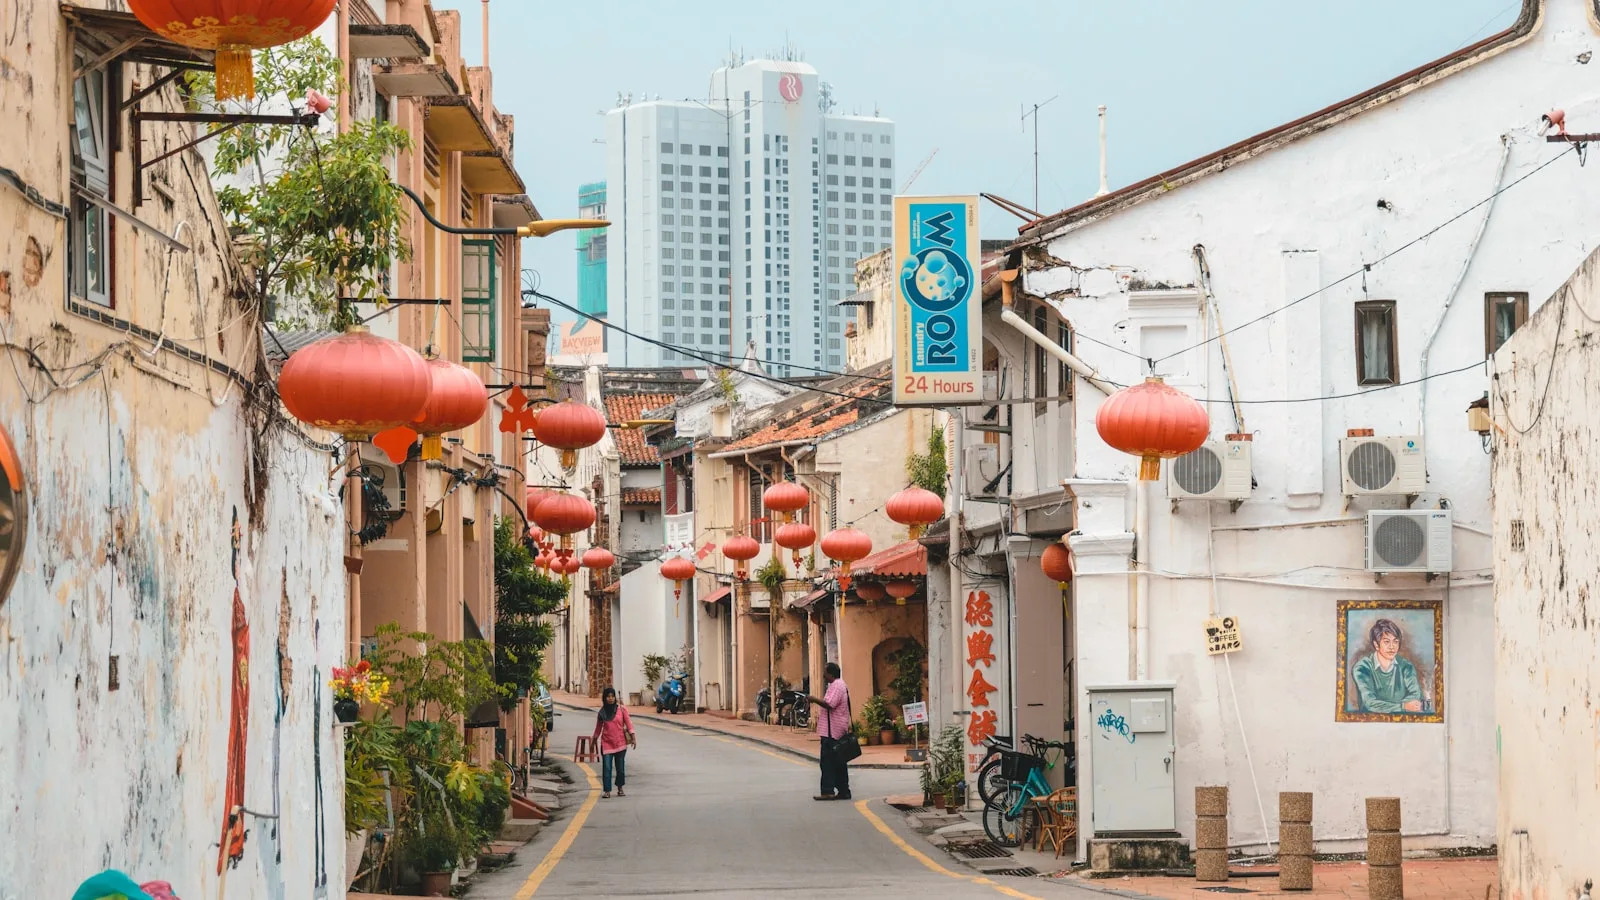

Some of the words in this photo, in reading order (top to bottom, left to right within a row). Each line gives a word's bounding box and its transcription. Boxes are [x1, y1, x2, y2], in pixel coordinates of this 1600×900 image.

[562, 336, 601, 348] BAYVIEW
[915, 322, 925, 367] Laundry
[905, 376, 928, 393] 24
[933, 379, 974, 393] Hours
[1209, 634, 1237, 643] COFFEE
[1215, 643, 1232, 651] BAR
